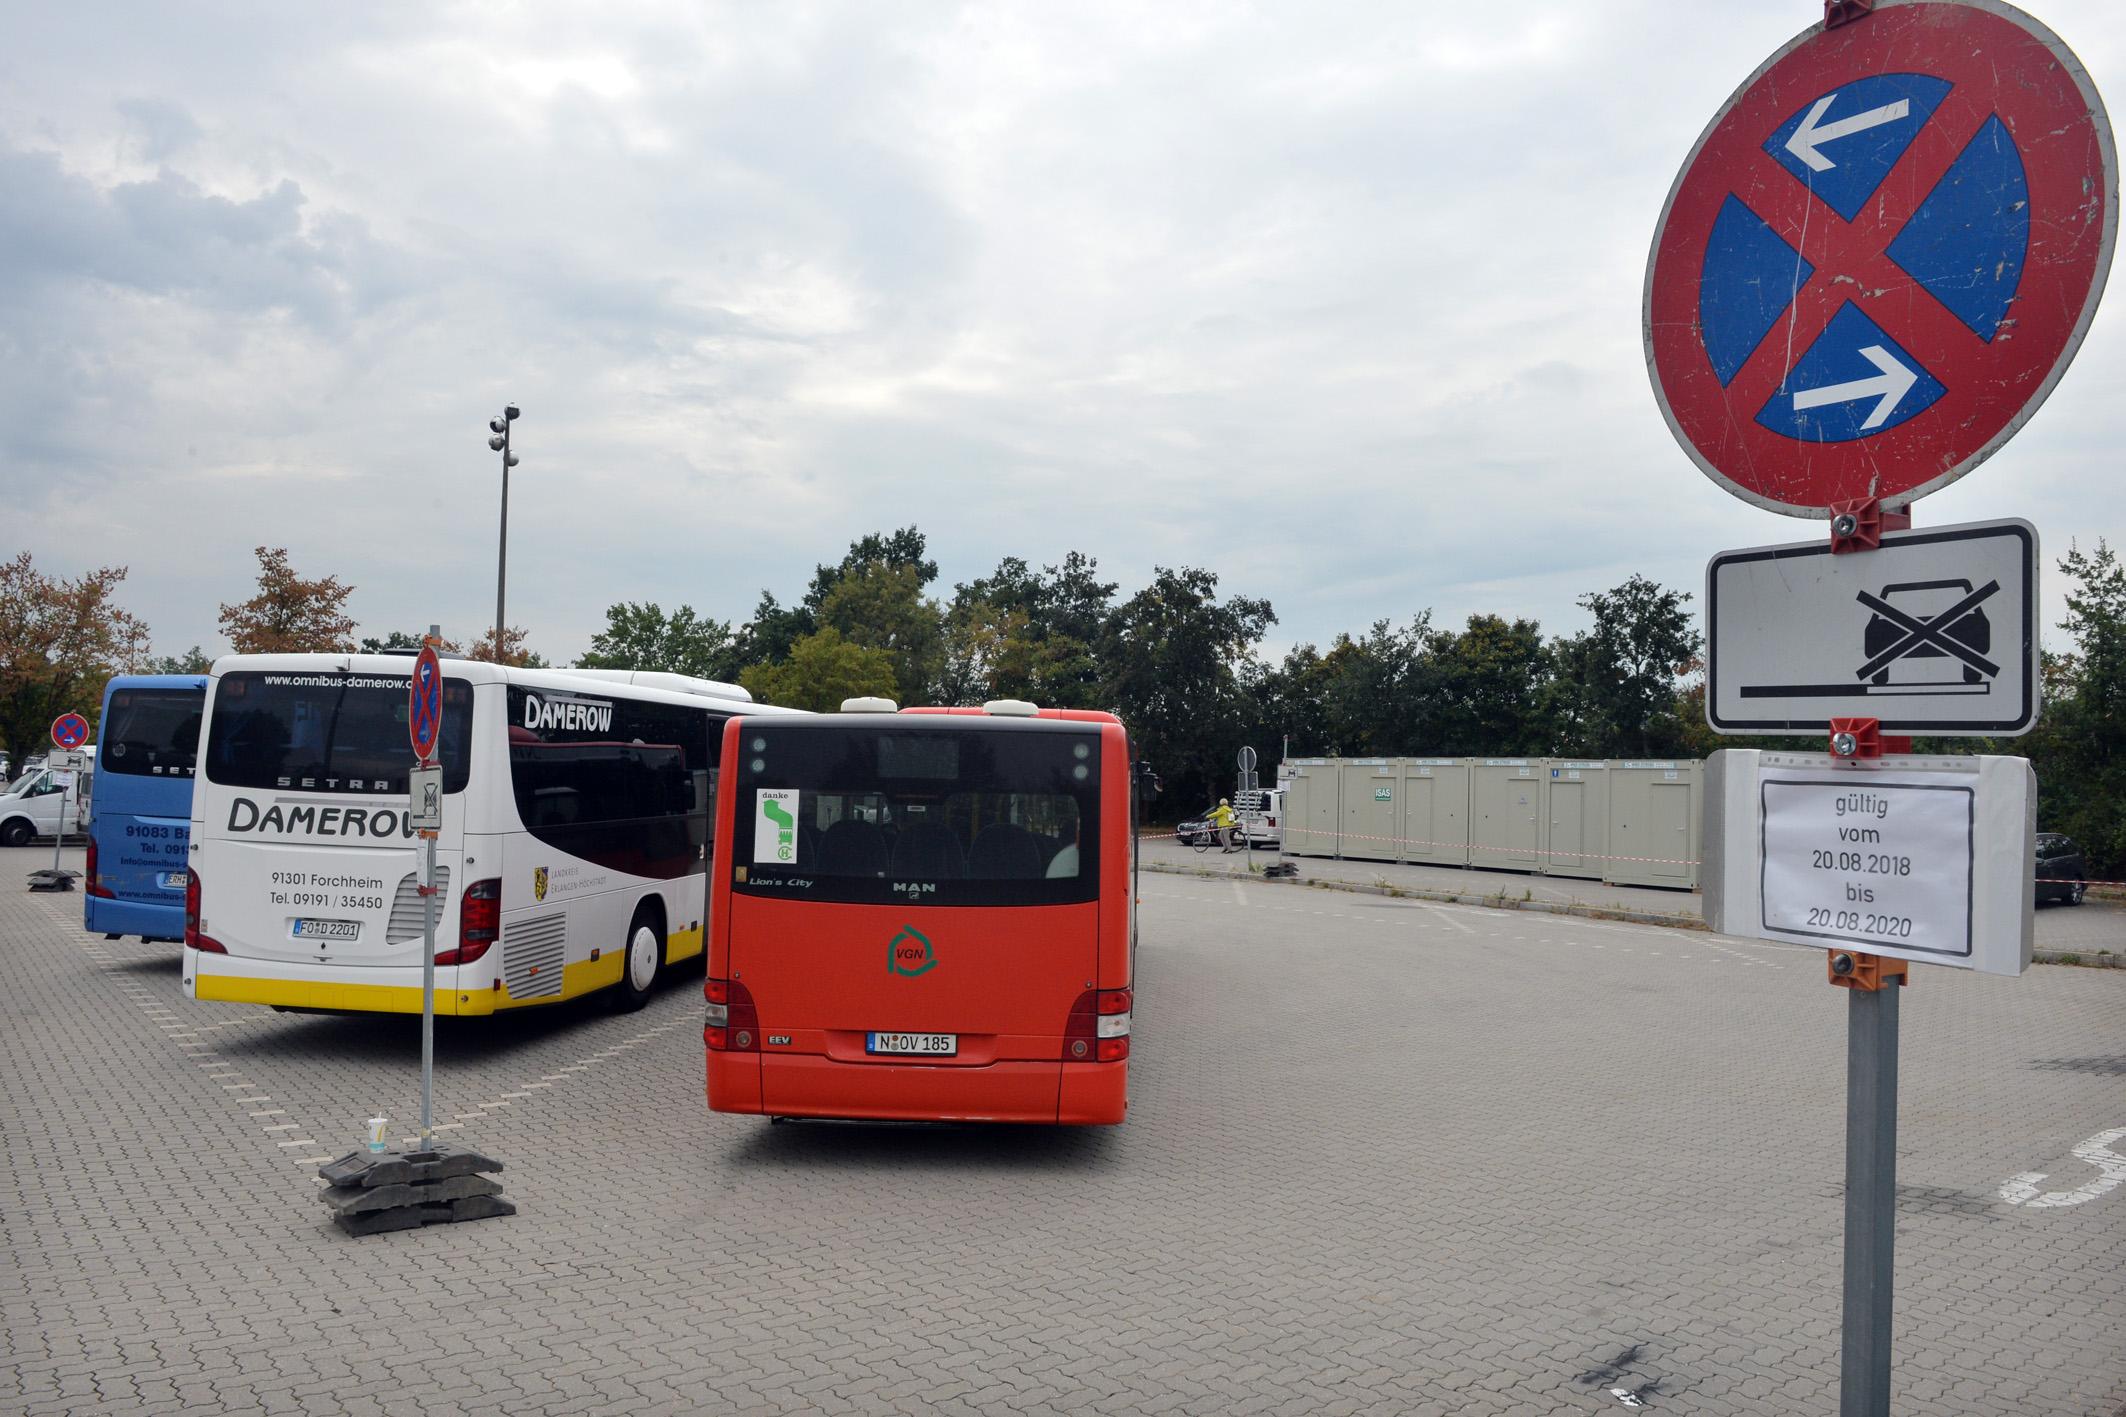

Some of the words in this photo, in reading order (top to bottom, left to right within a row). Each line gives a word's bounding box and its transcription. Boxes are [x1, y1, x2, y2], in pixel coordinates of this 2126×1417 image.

[524, 694, 612, 732] DAMEROW
[277, 776, 388, 790] SETRA
[1375, 788, 1391, 798] ISAS
[1836, 793, 1888, 819] gültig
[126, 825, 168, 838] 91083
[1838, 827, 1880, 843] vom
[140, 843, 159, 854] Tel.
[1812, 850, 1911, 876] 20.08.2018
[271, 872, 306, 885] 91301
[311, 874, 383, 889] Forchheim
[787, 879, 814, 888] City
[893, 882, 936, 892] MAN
[1846, 882, 1874, 903] bis
[270, 892, 290, 904] Tel.
[293, 893, 329, 906] 09191
[341, 896, 383, 909] 35450
[329, 923, 356, 936] 2201
[1807, 907, 1912, 938] 20.08.2020
[896, 948, 924, 959] VGN
[769, 1036, 791, 1044] EEV
[923, 1036, 950, 1051] 185
